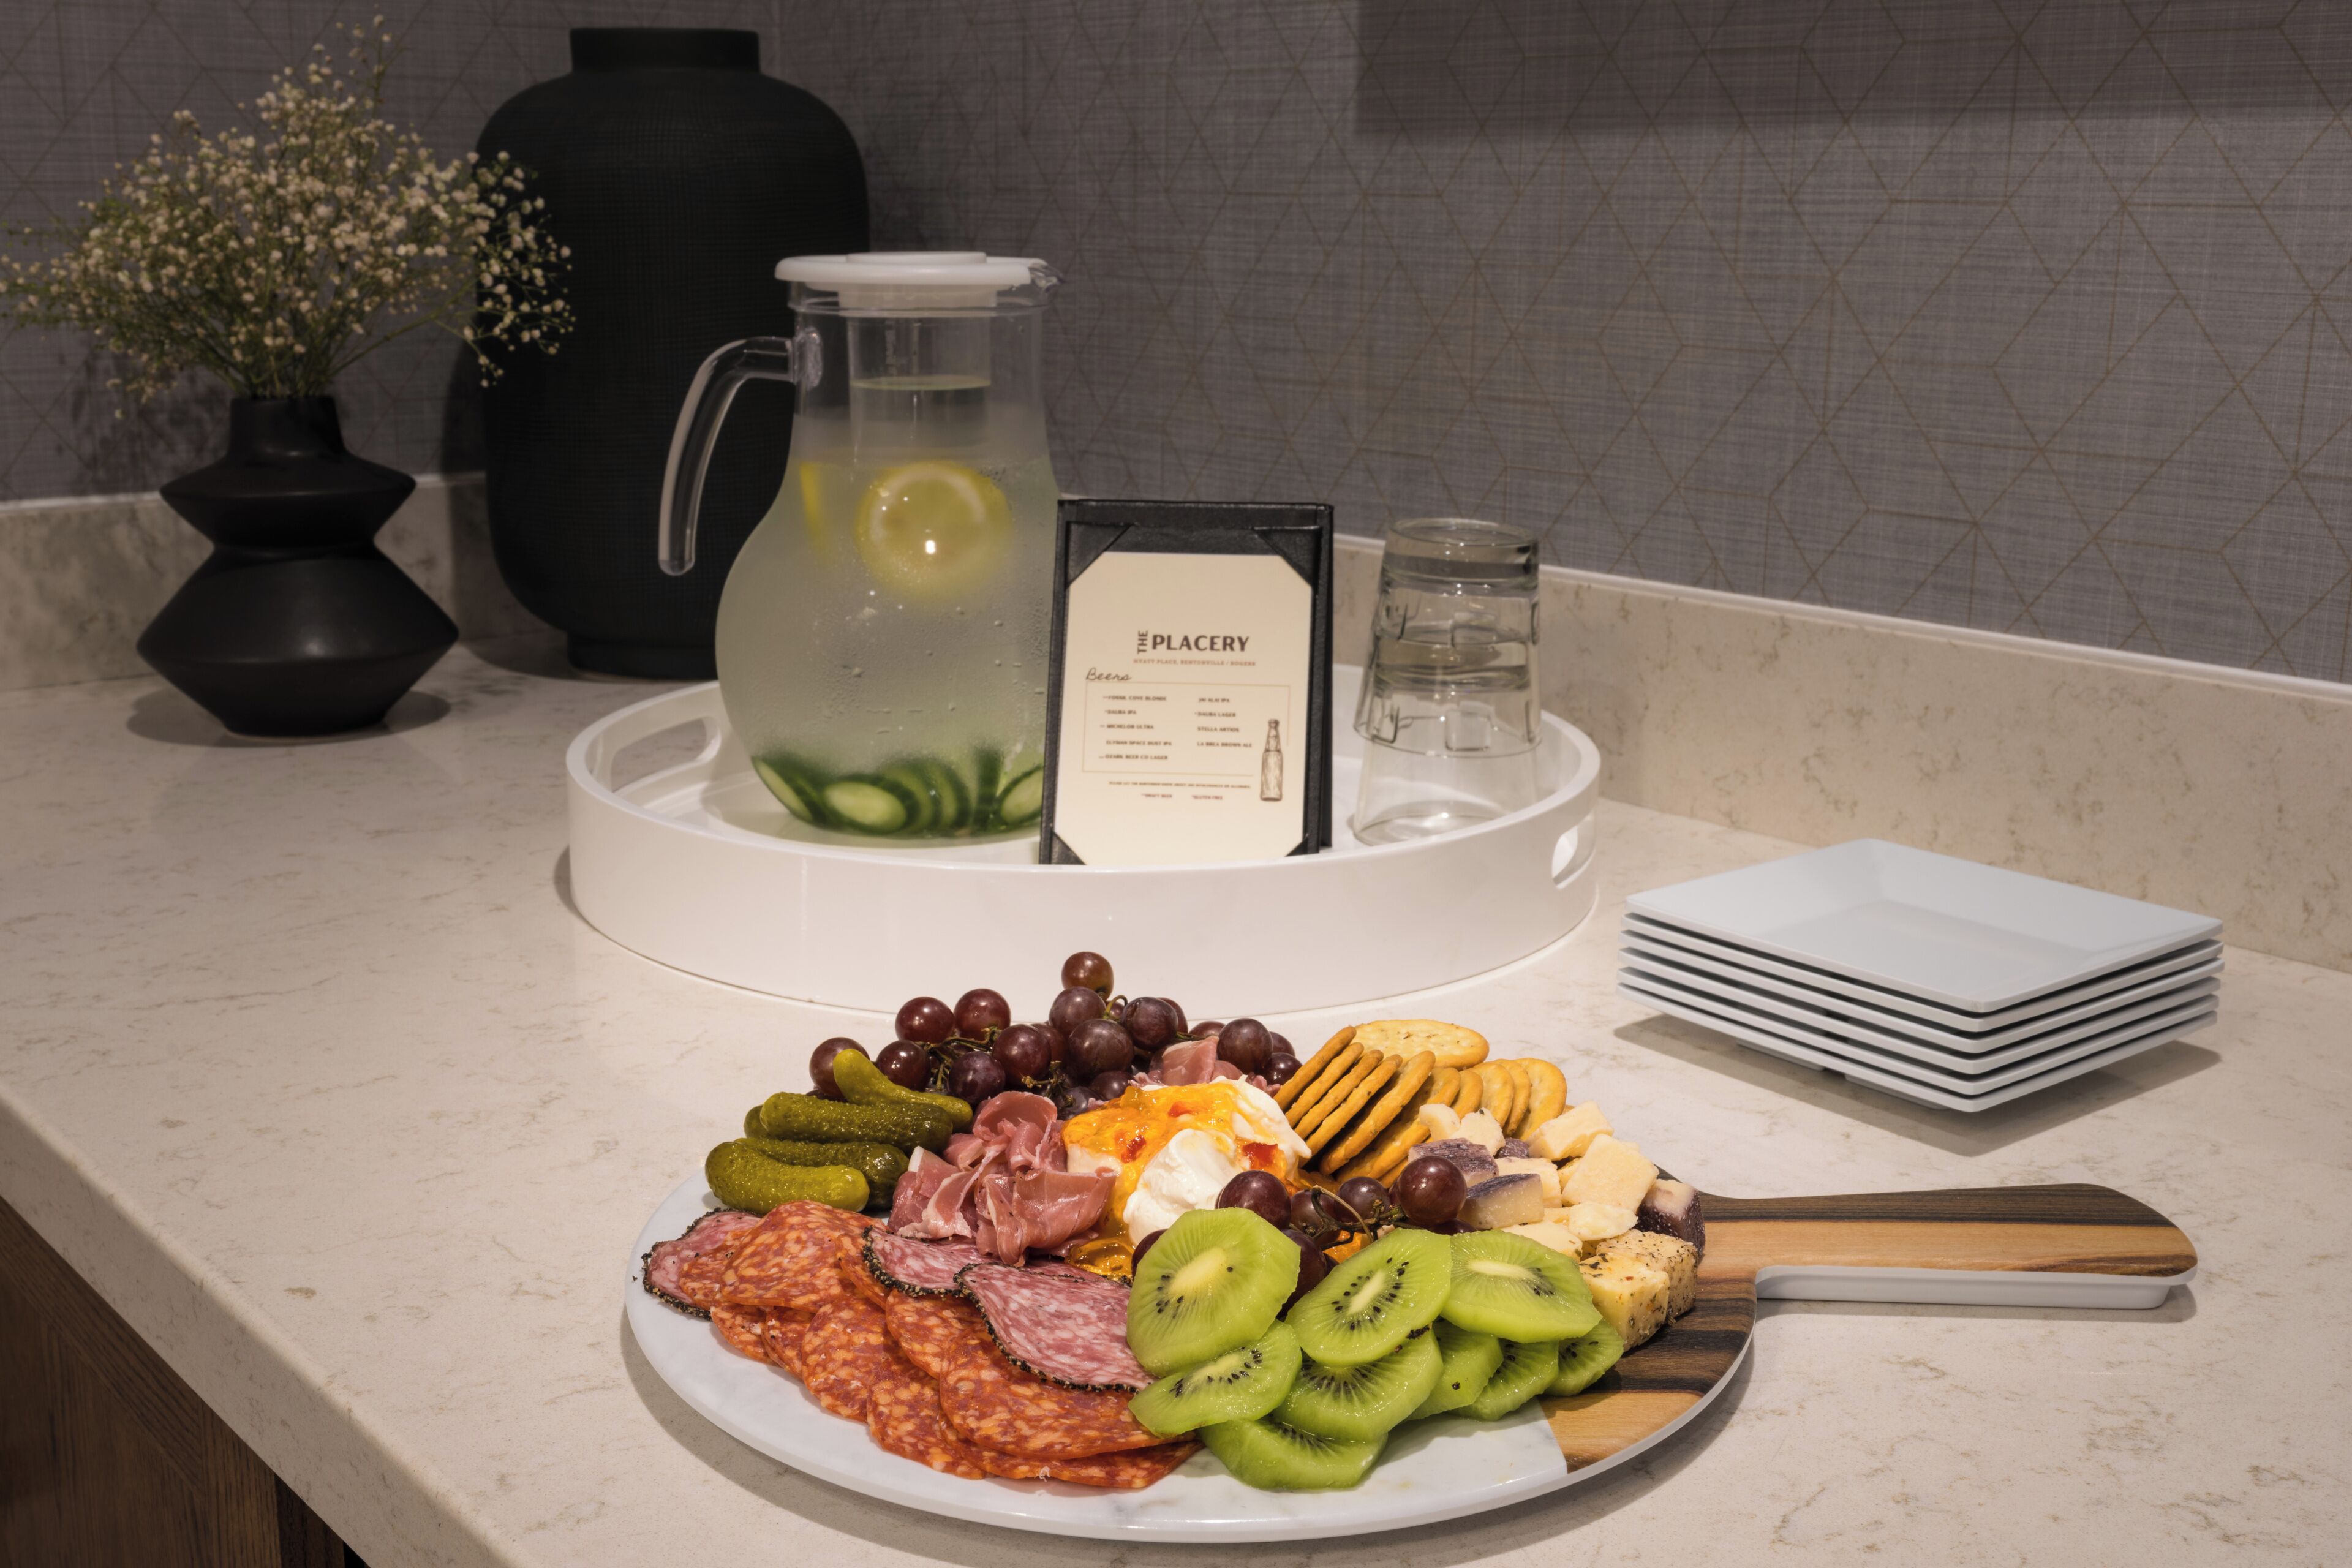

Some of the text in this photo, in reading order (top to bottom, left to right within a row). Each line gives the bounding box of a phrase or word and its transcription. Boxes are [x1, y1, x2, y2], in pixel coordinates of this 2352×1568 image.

[1137, 630, 1250, 654] THE PLACERY
[1085, 667, 1132, 682] Beers
